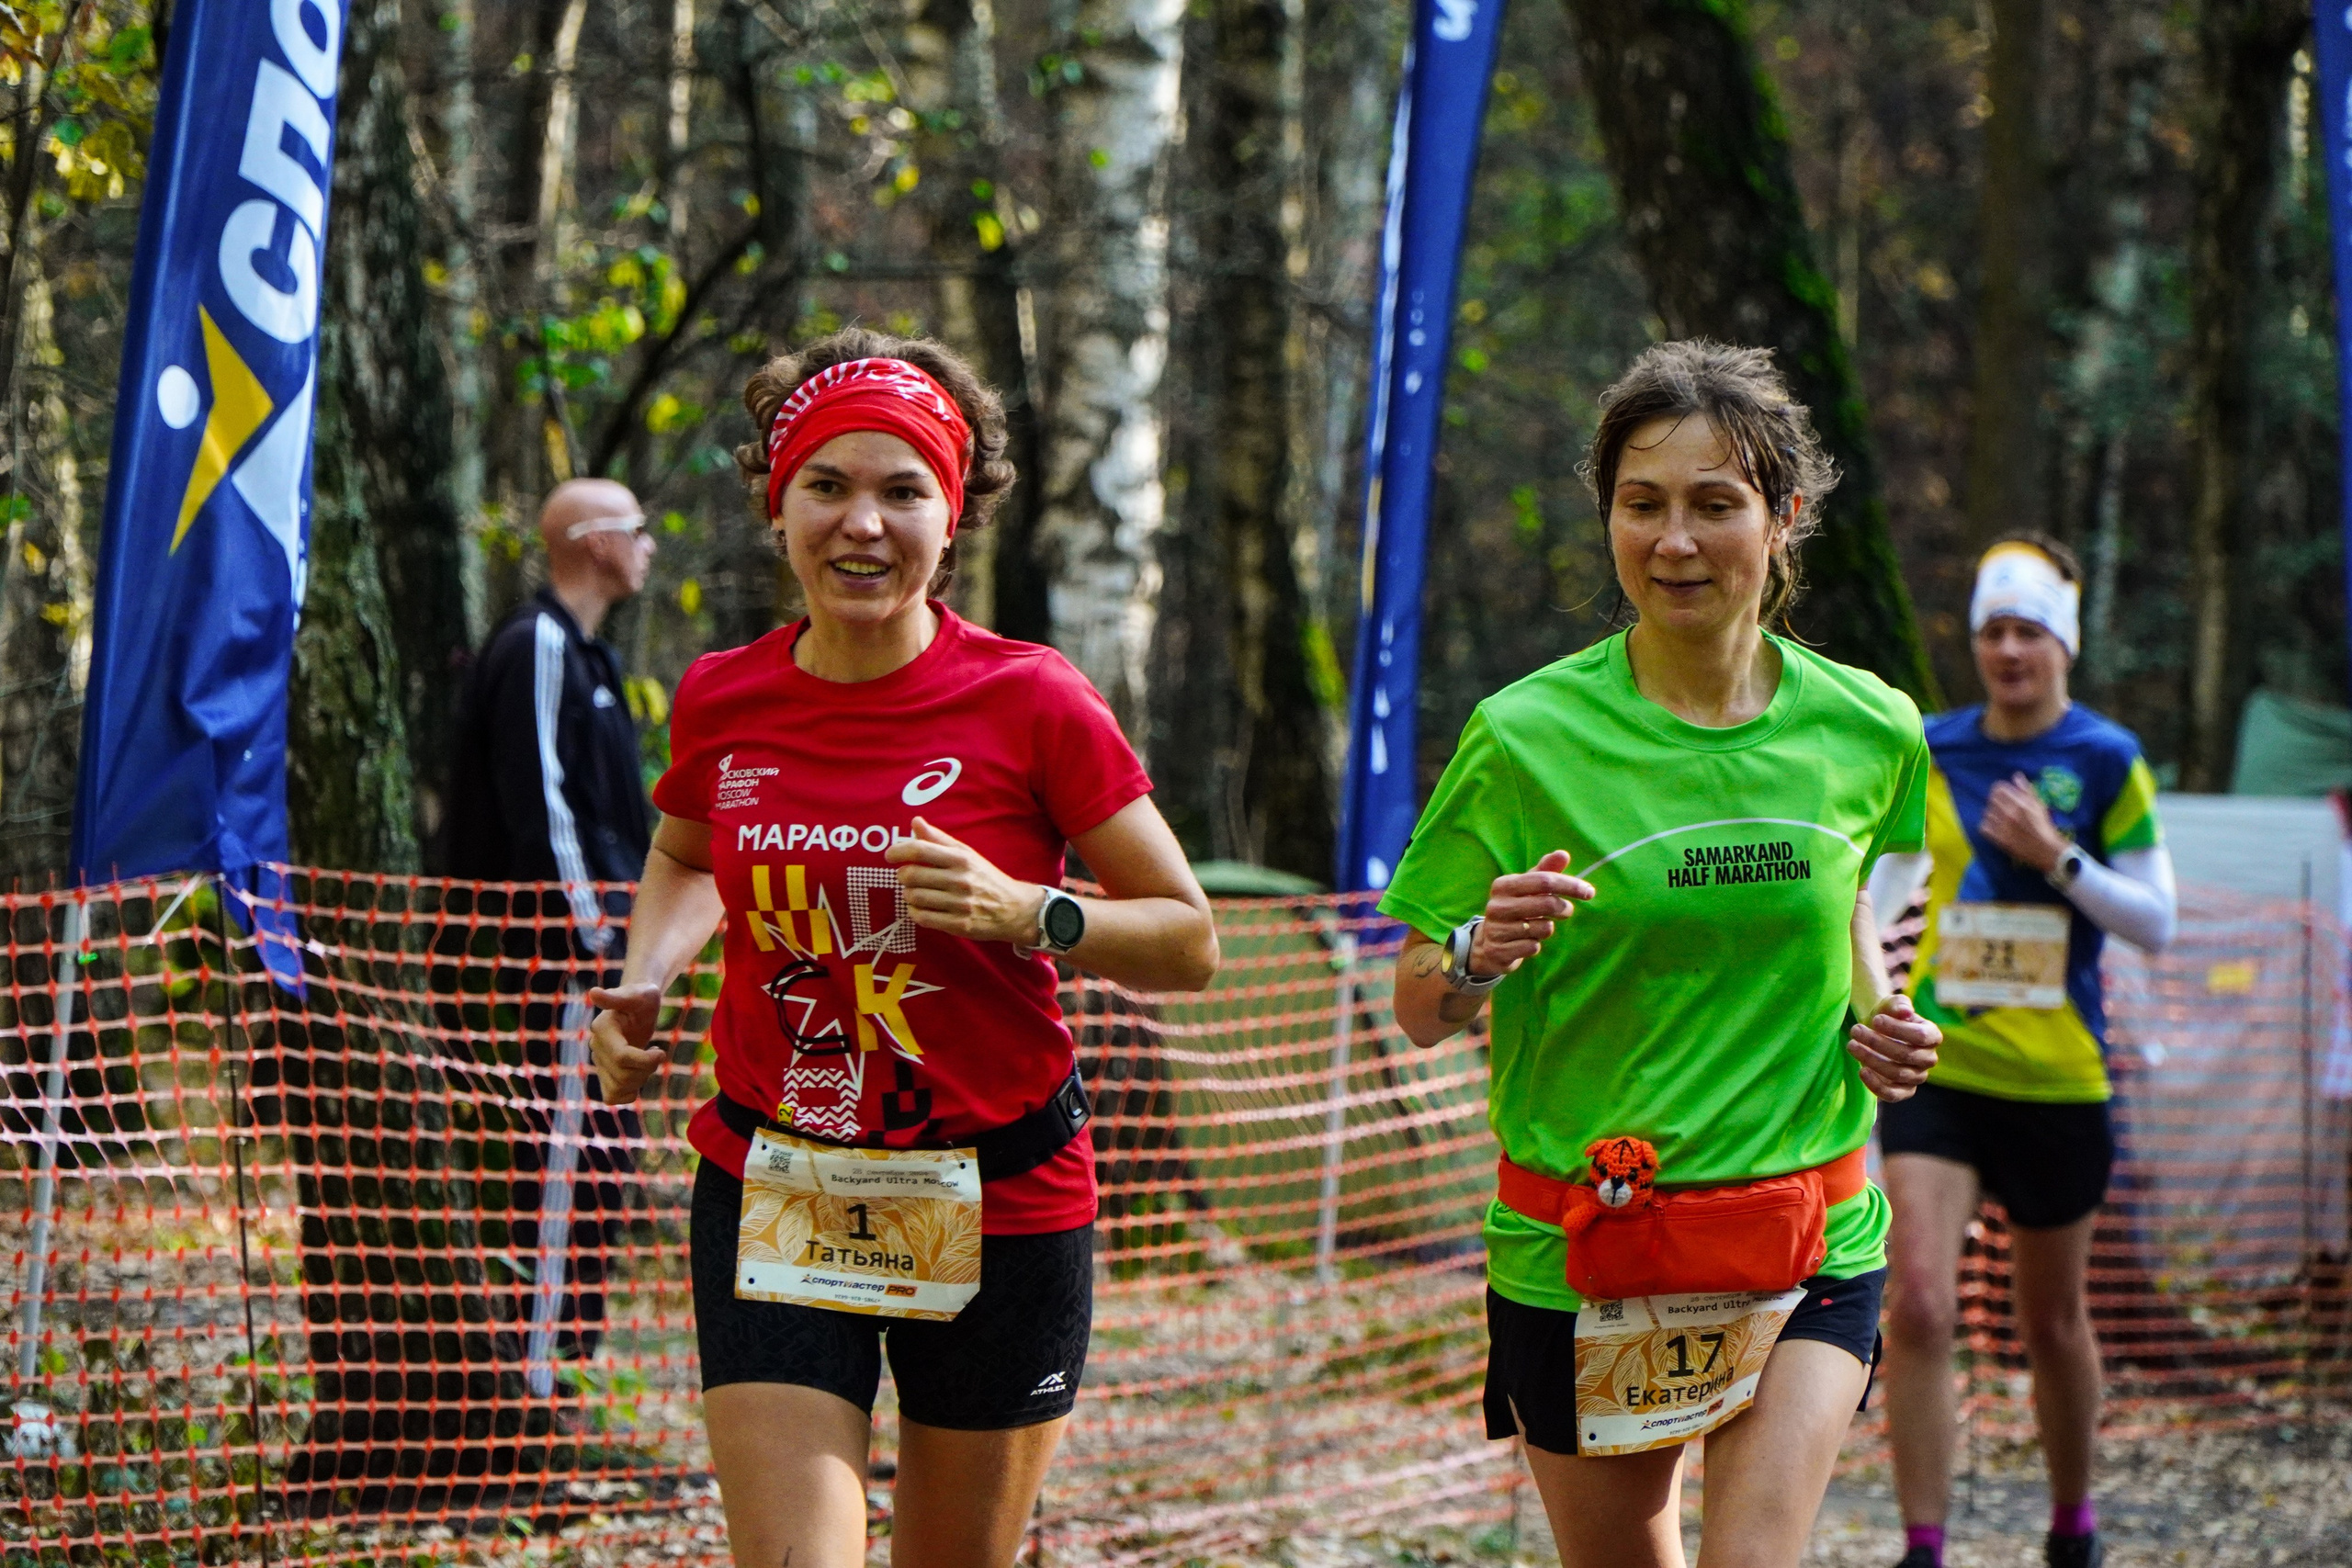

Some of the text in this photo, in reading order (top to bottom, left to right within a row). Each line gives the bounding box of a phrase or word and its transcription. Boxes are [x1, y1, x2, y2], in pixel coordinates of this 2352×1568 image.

[718, 767, 780, 781] ОСКОВСКИЙ
[1683, 840, 1793, 867] SAMARKAND
[1668, 859, 1812, 888] HALF MARATHON
[831, 1173, 881, 1186] Backyard
[887, 1176, 918, 1185] Ultra
[846, 1203, 876, 1242] 1
[805, 1240, 914, 1271] Татьяна
[888, 1285, 915, 1296] PRO
[1668, 1303, 1718, 1314] Backyard
[1666, 1331, 1725, 1378] 17
[1030, 1383, 1067, 1396] ATHLEX
[1626, 1365, 1735, 1407] Екатерина
